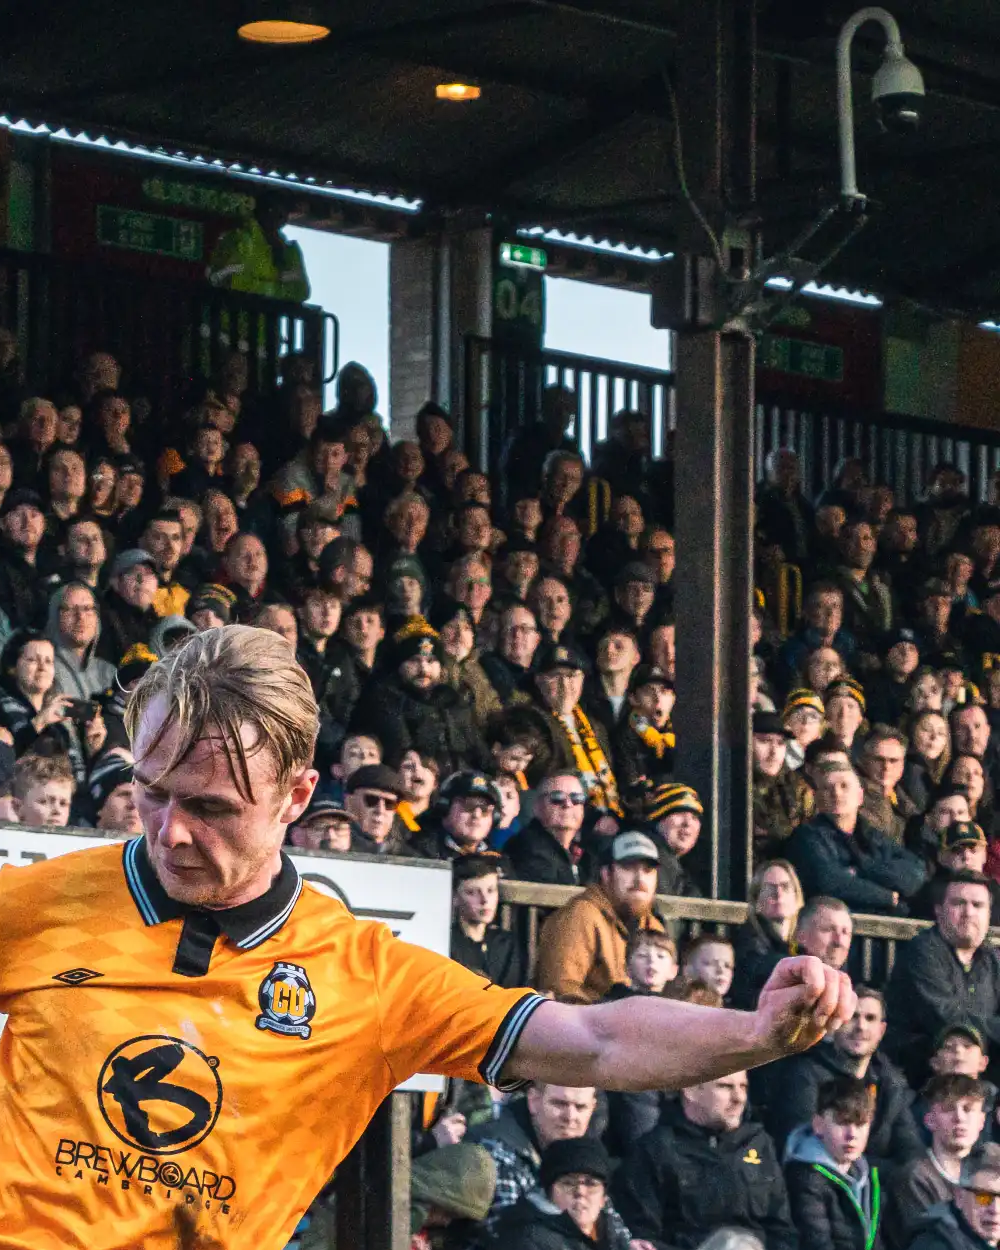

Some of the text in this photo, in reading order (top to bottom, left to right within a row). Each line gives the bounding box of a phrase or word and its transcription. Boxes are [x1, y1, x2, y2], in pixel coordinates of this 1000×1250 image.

[496, 279, 540, 324] 04
[272, 981, 306, 1017] CU
[55, 1139, 236, 1201] BREWBOARD
[55, 1166, 230, 1214] CAMBRIDGE
